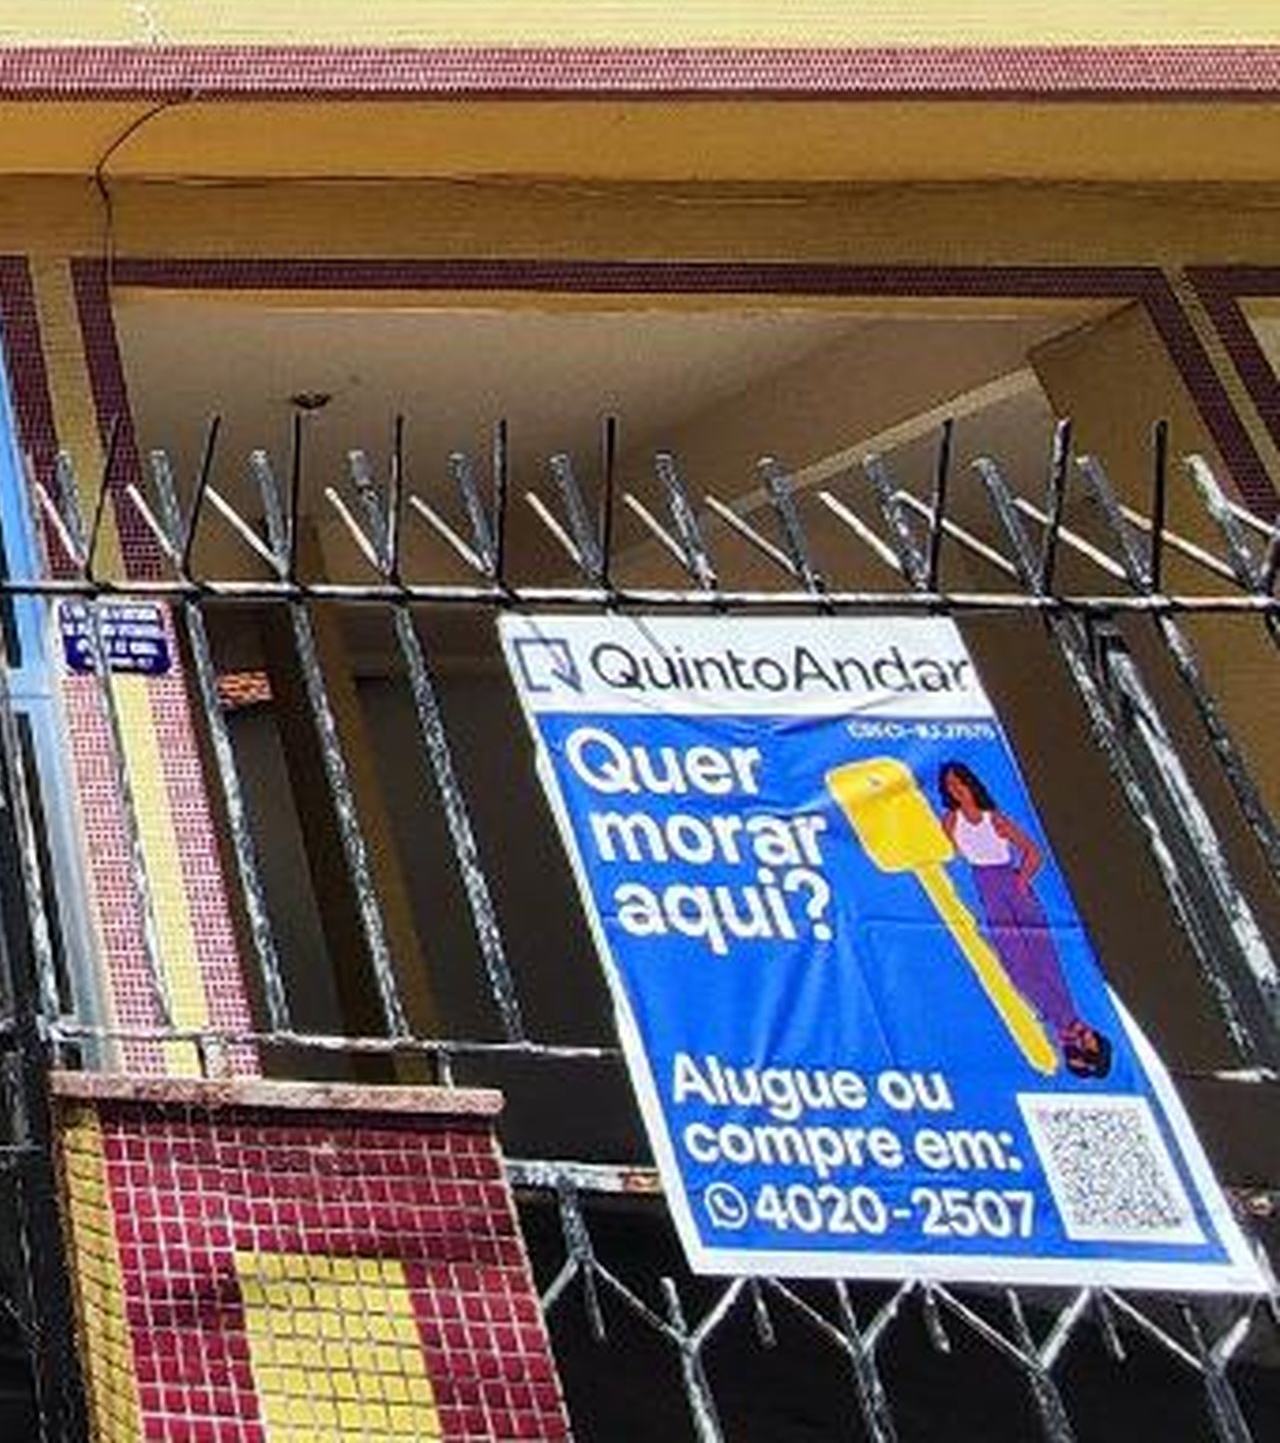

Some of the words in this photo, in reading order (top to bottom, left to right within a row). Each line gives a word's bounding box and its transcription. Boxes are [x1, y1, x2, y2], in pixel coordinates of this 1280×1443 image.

[591, 643, 970, 693] QuintoAndar
[565, 727, 762, 795] Quer
[590, 811, 827, 866] morar
[613, 868, 834, 955] aqui?
[673, 1053, 867, 1121] Alugue
[878, 1070, 954, 1111] ou
[684, 1122, 904, 1178] compre
[915, 1129, 1024, 1171] em:
[755, 1184, 1035, 1238] 4020-2507
